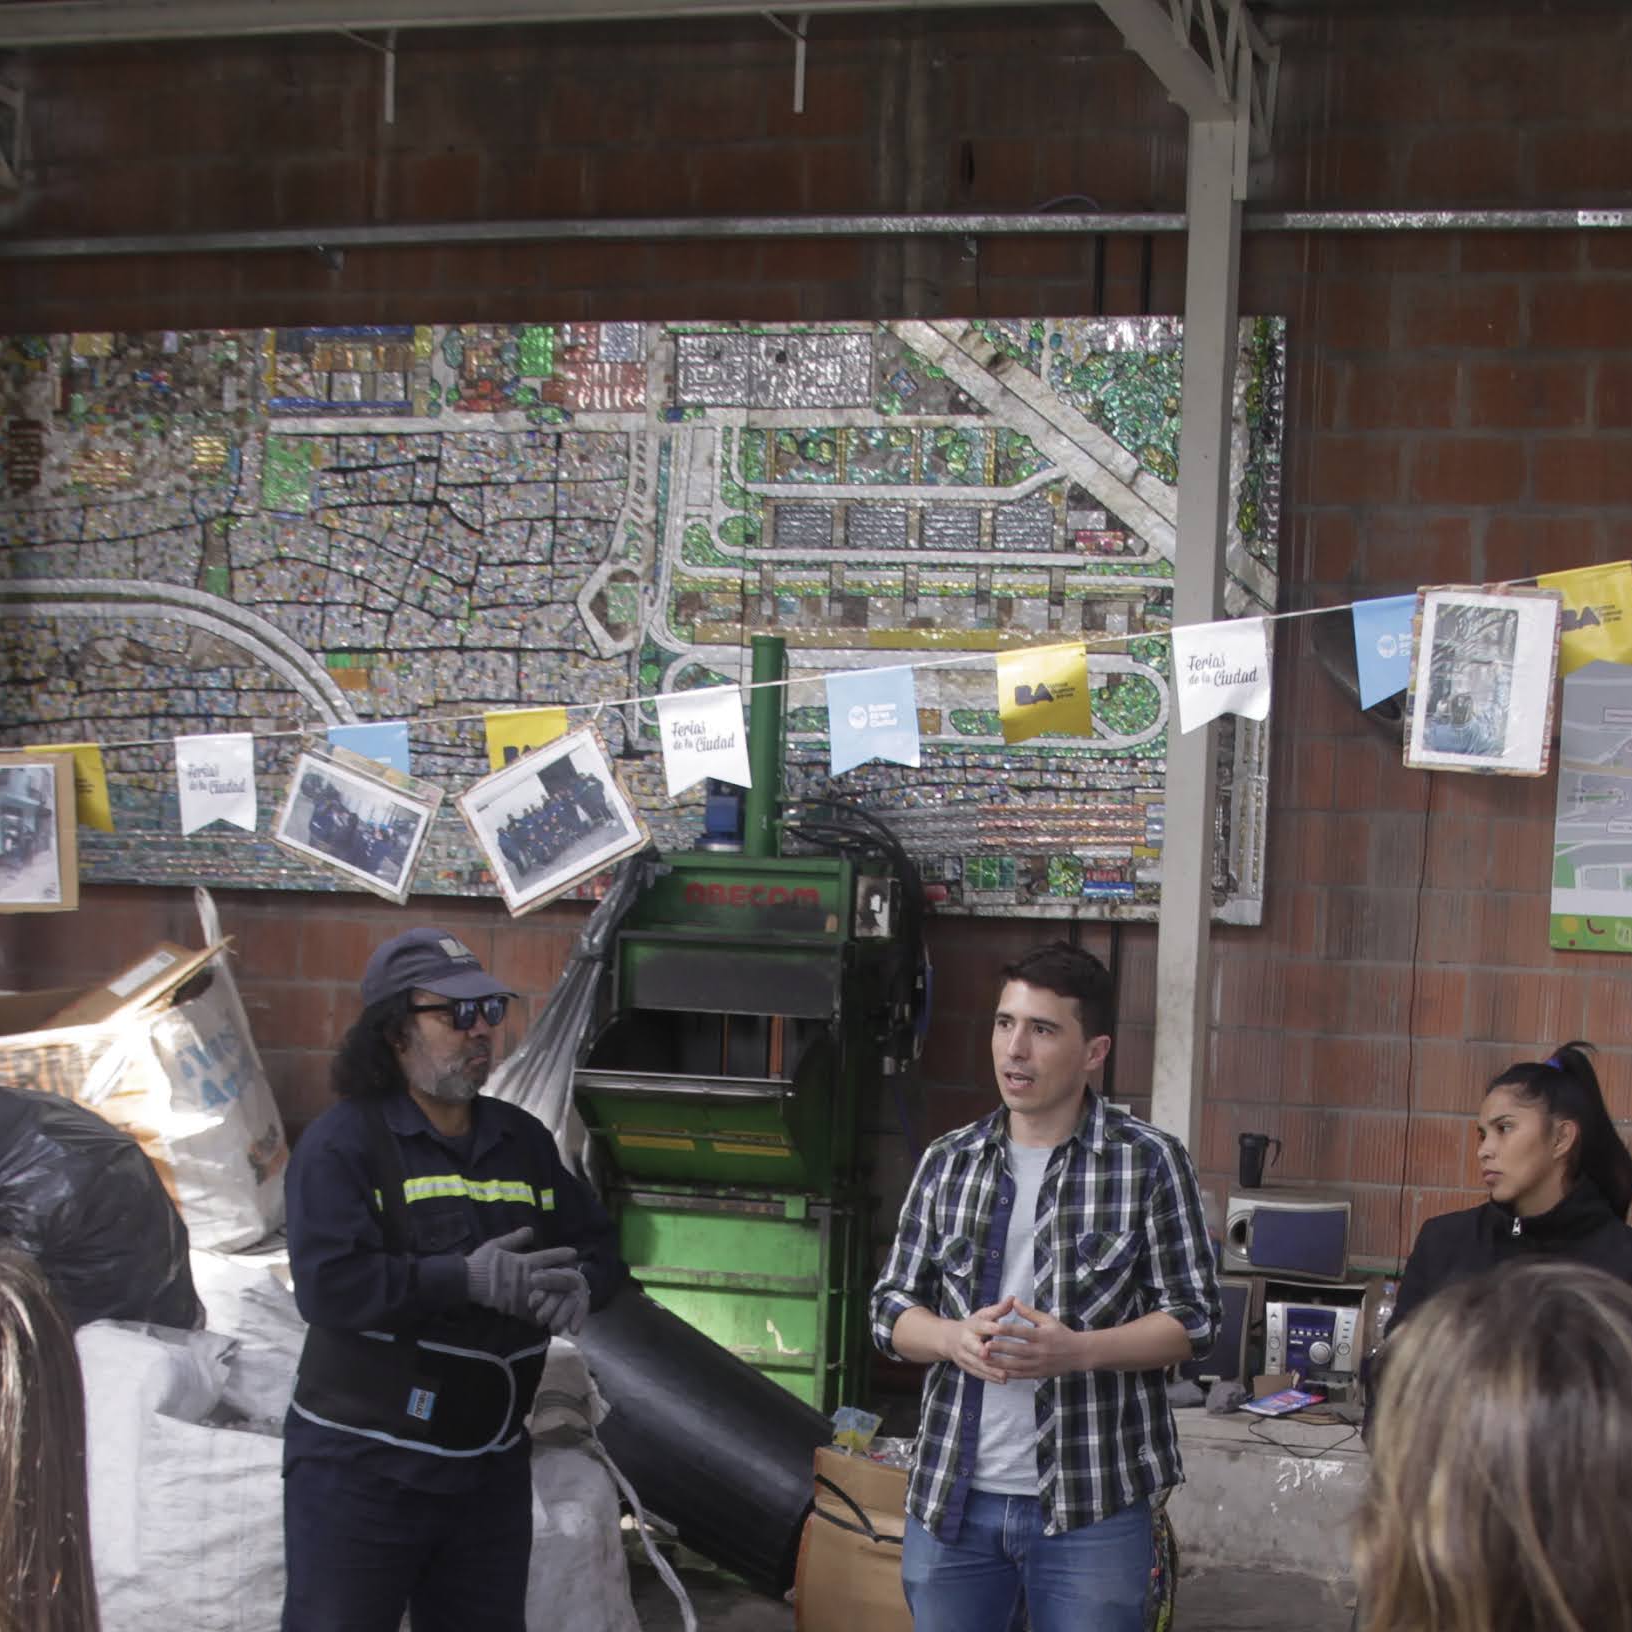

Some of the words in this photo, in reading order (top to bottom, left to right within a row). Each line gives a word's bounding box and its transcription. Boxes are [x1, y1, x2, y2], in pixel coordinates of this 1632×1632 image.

[1188, 652, 1226, 671] Ferias
[1214, 666, 1258, 687] Ciudad
[1015, 683, 1054, 706] BA
[671, 720, 706, 737] Ferias
[696, 731, 735, 752] Ciudad
